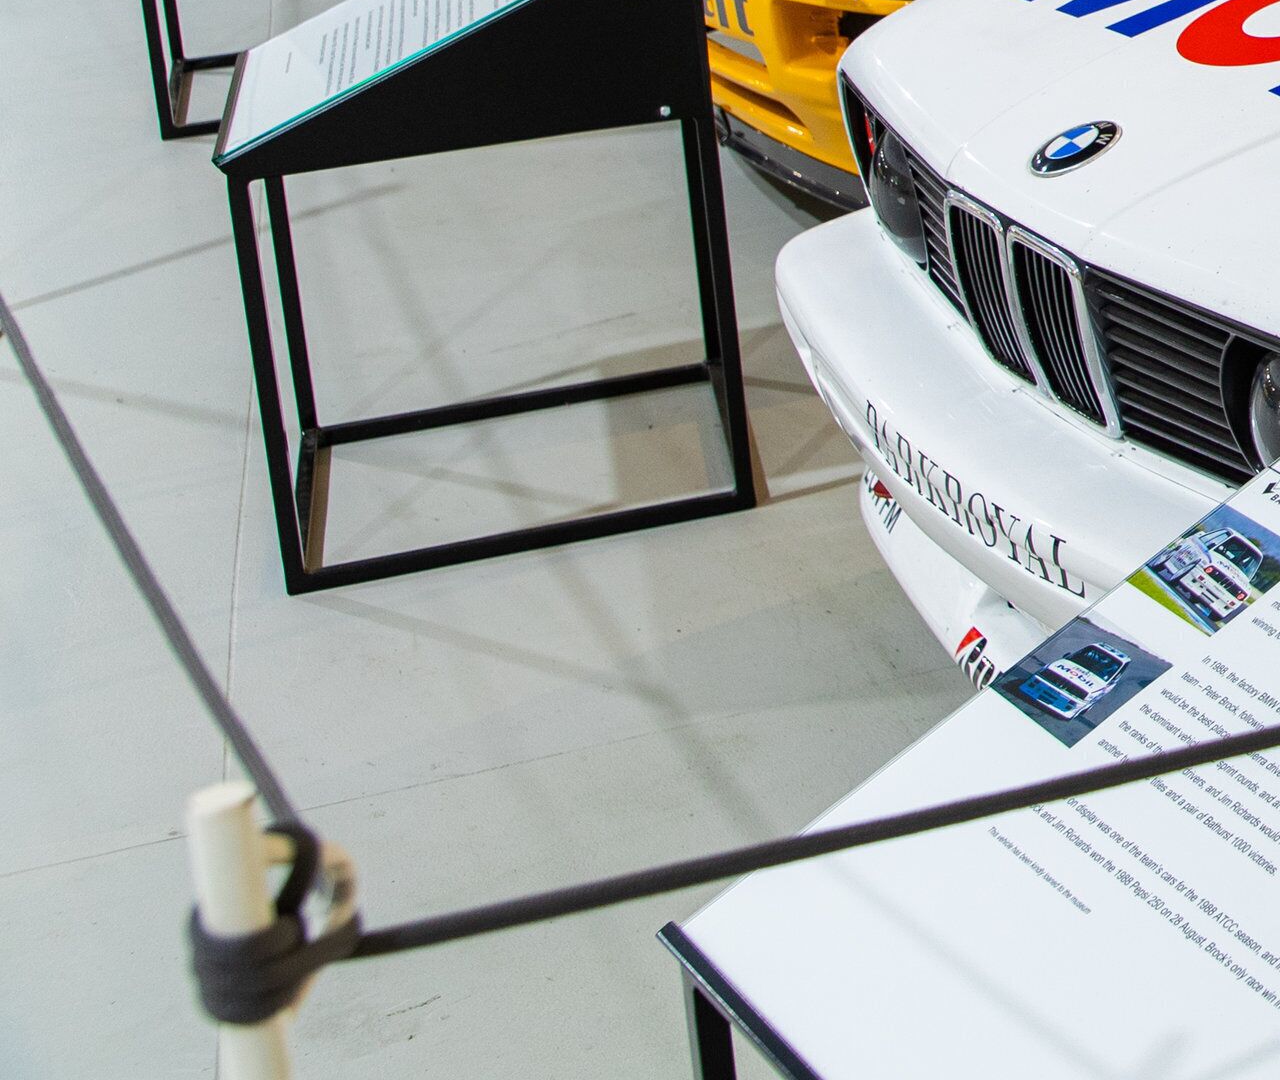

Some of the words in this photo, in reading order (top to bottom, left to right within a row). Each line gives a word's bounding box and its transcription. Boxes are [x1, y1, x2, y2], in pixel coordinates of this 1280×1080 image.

[866, 399, 1086, 600] PARKROYAL
[1247, 614, 1280, 637] winning
[1200, 653, 1215, 665] In
[1206, 658, 1232, 678] 1988,
[1056, 663, 1095, 689] Mobil
[1224, 669, 1243, 683] the
[1233, 676, 1263, 699] factory
[1038, 808, 1058, 824] and
[1049, 817, 1069, 833] Jim
[1061, 826, 1095, 854] Richards
[1087, 849, 1106, 865] won
[1100, 857, 1119, 873] the
[1111, 867, 1135, 887] 1988
[1125, 879, 1154, 903] Pepsi
[1145, 894, 1166, 911] 250
[1158, 906, 1173, 919] on
[1167, 911, 1185, 927] 28
[1174, 919, 1211, 949] August,
[1203, 940, 1236, 968] Brock's
[1225, 960, 1251, 982] only
[1242, 974, 1265, 993] race
[1259, 985, 1280, 1004] win
